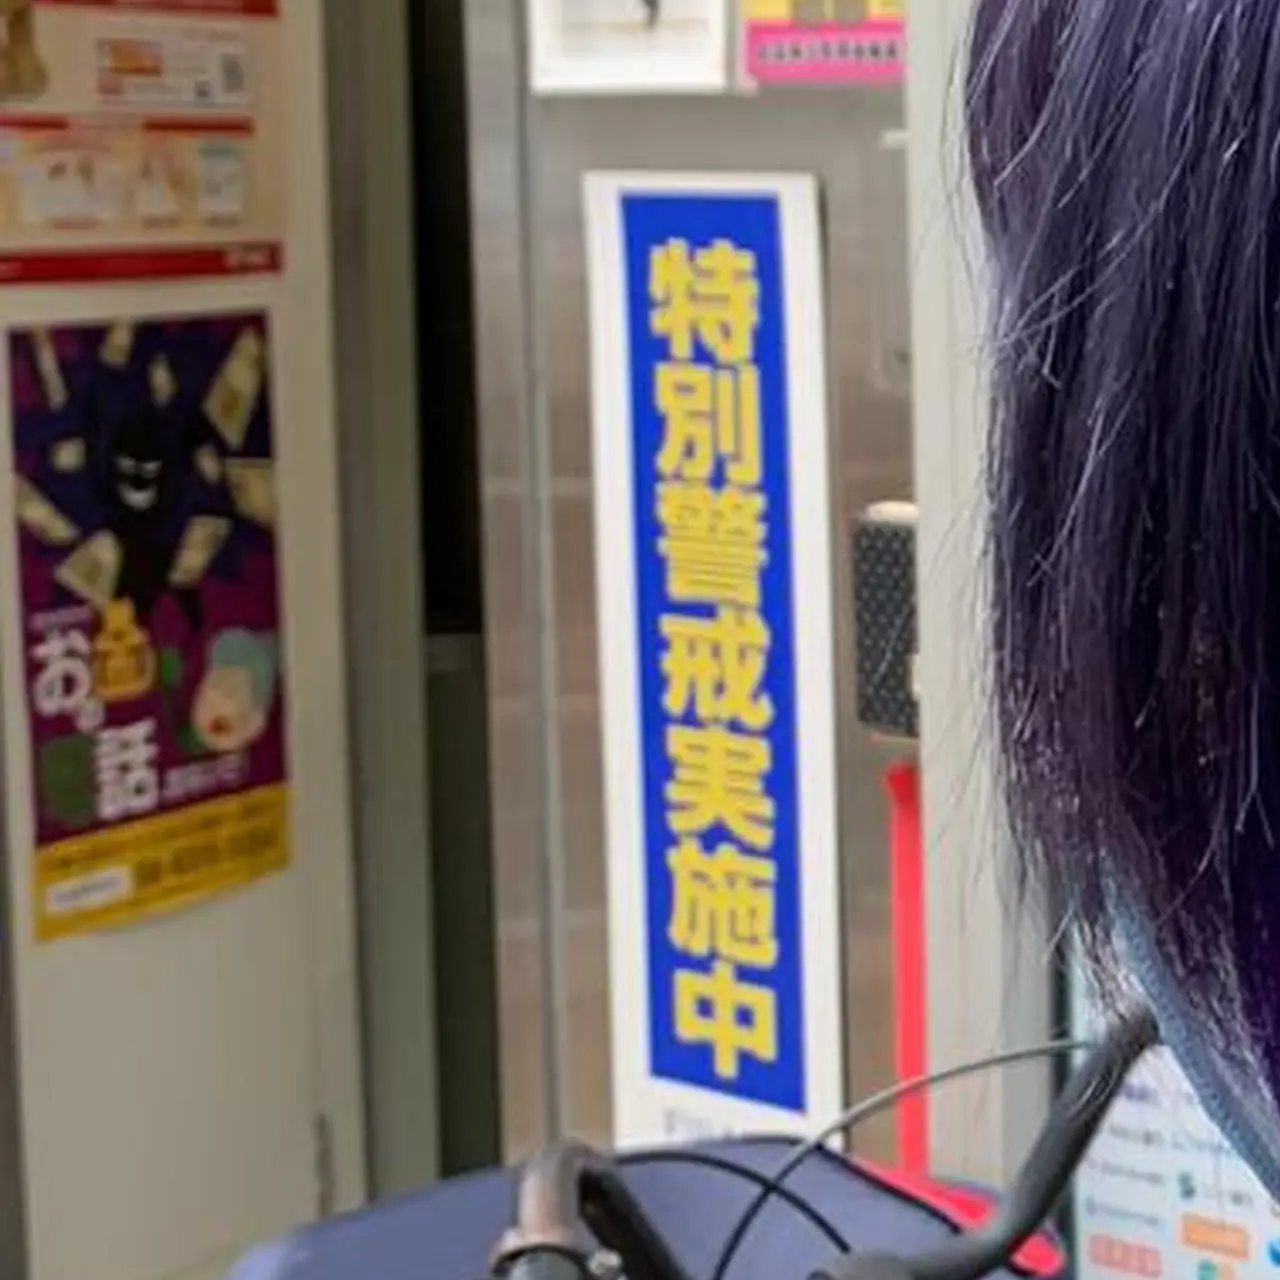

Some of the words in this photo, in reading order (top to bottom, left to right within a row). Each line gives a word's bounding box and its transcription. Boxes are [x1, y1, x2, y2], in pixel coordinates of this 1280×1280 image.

[648, 236, 778, 1080] 特別警戒実施中
